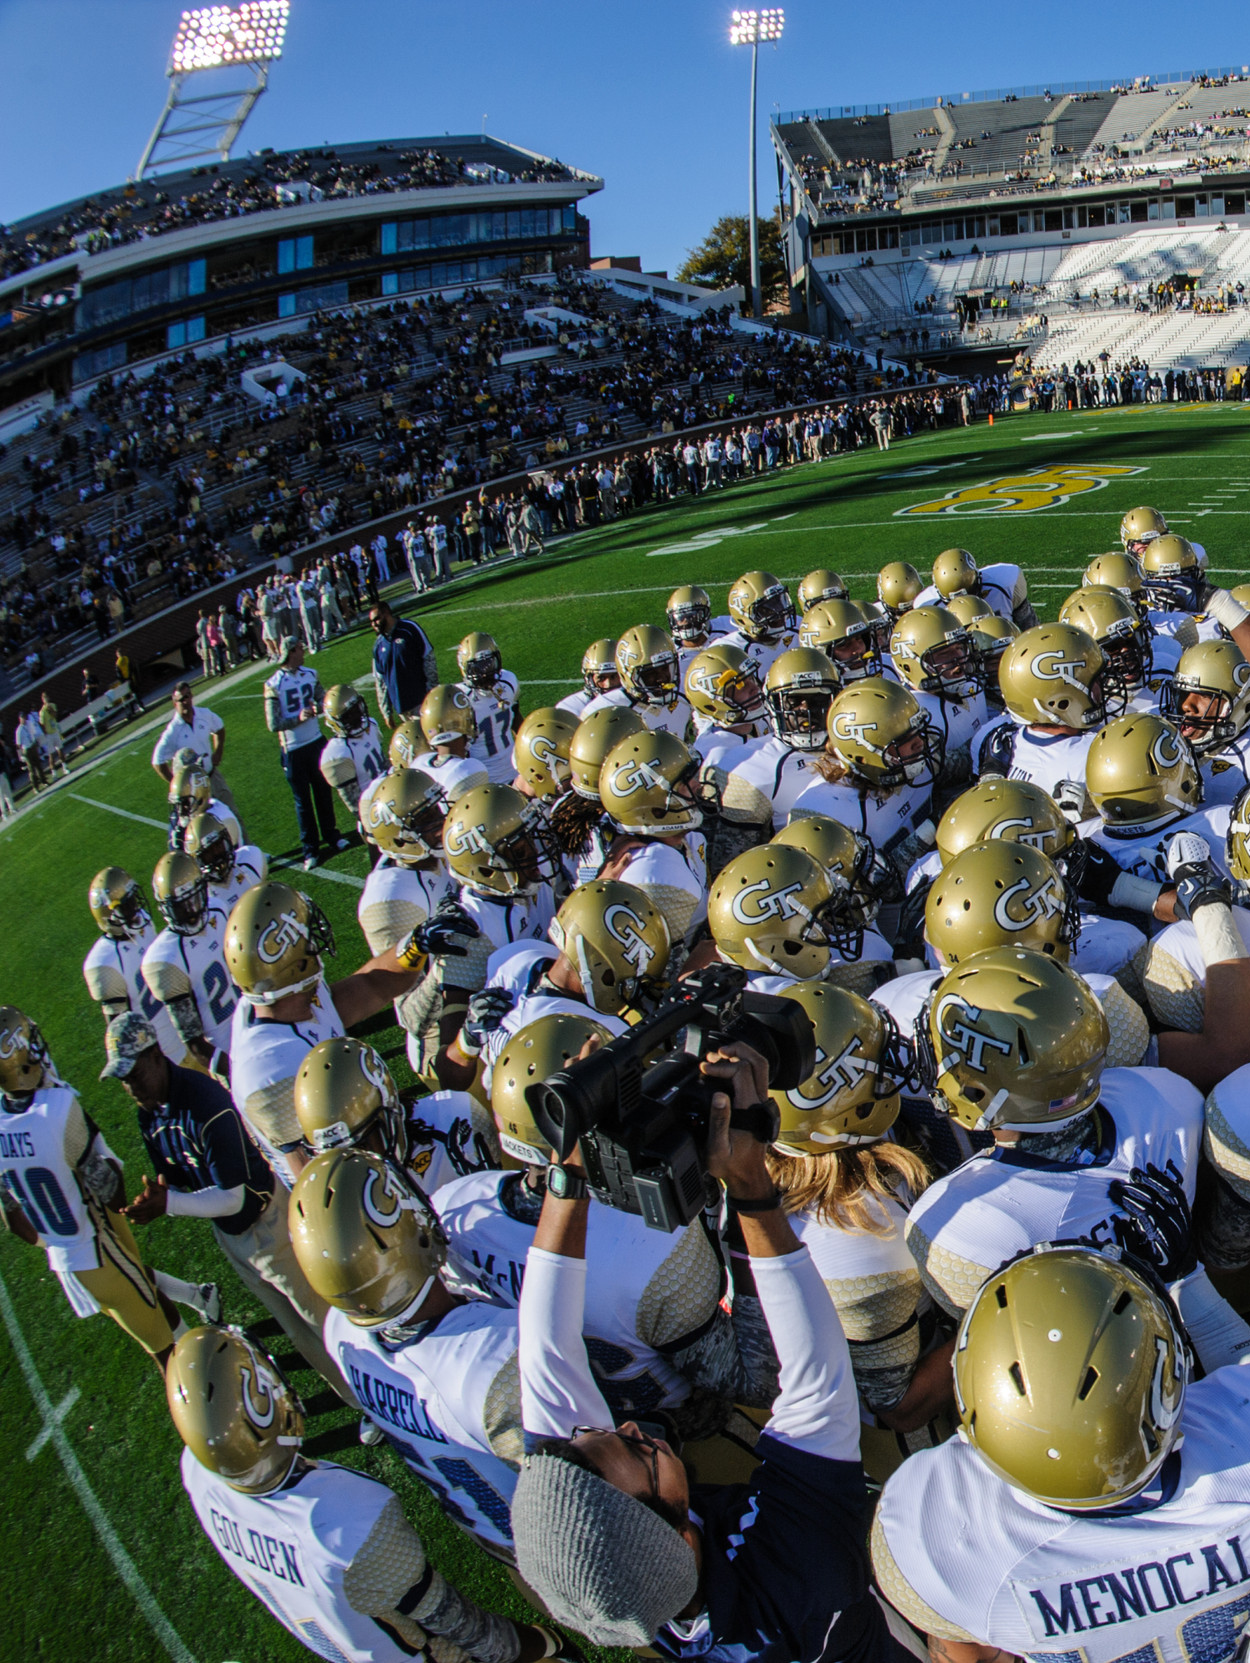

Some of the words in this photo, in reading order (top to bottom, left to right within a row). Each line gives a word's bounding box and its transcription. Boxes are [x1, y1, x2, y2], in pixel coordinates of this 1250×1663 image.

[688, 667, 722, 699] GT
[1030, 650, 1086, 685] GT
[285, 682, 313, 718] 52
[478, 706, 512, 757] 17
[832, 712, 878, 752] GT
[609, 758, 661, 798] GT
[445, 822, 486, 857] GT
[731, 879, 803, 926] GT
[994, 876, 1066, 932] GT
[258, 910, 309, 964] GT
[603, 903, 655, 965] GT
[935, 993, 1014, 1074] GT
[0, 1131, 36, 1158] DAYS
[508, 1122, 519, 1135] 46
[2, 1166, 80, 1237] 10
[349, 1364, 449, 1445] HARRELL
[209, 1507, 305, 1588] GOLDEN
